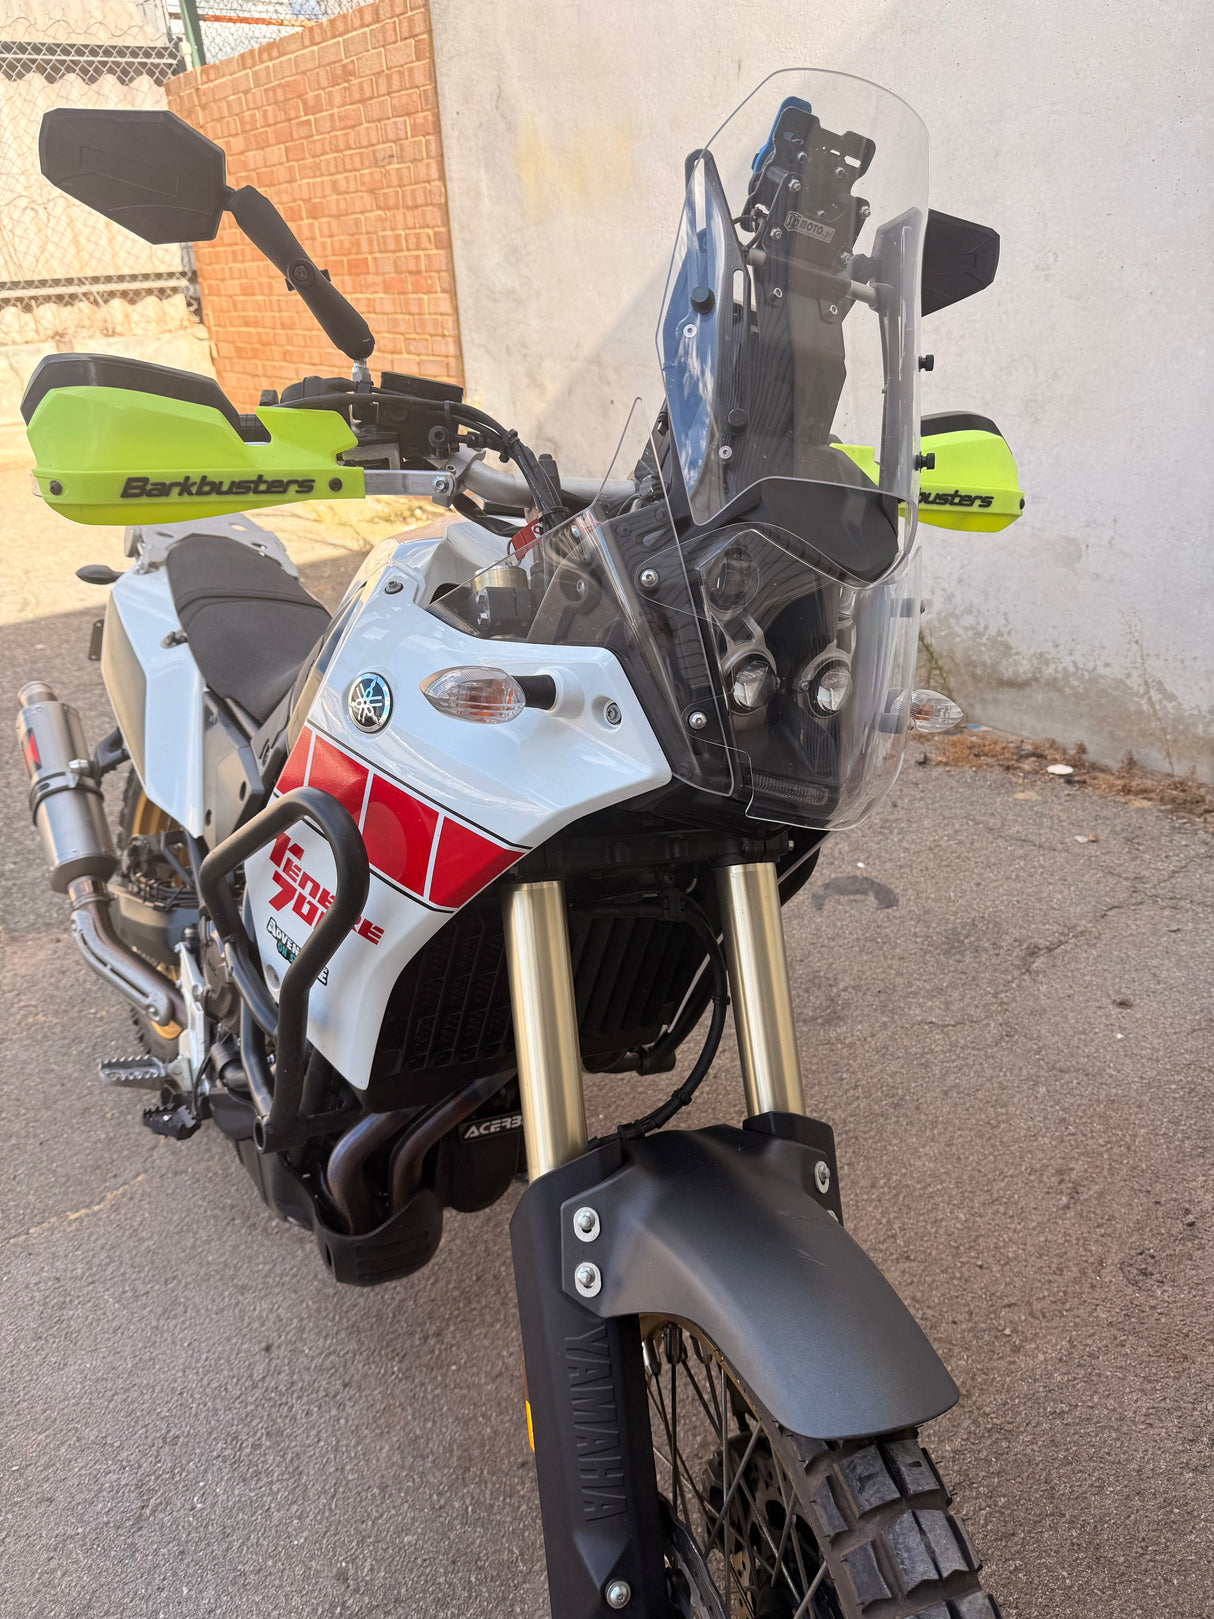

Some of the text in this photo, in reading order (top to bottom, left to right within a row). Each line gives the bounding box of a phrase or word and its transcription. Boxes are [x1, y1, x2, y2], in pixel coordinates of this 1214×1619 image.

[120, 474, 316, 498] Barkbusters
[268, 870, 325, 930] 70
[564, 1324, 628, 1522] YAMAHA
